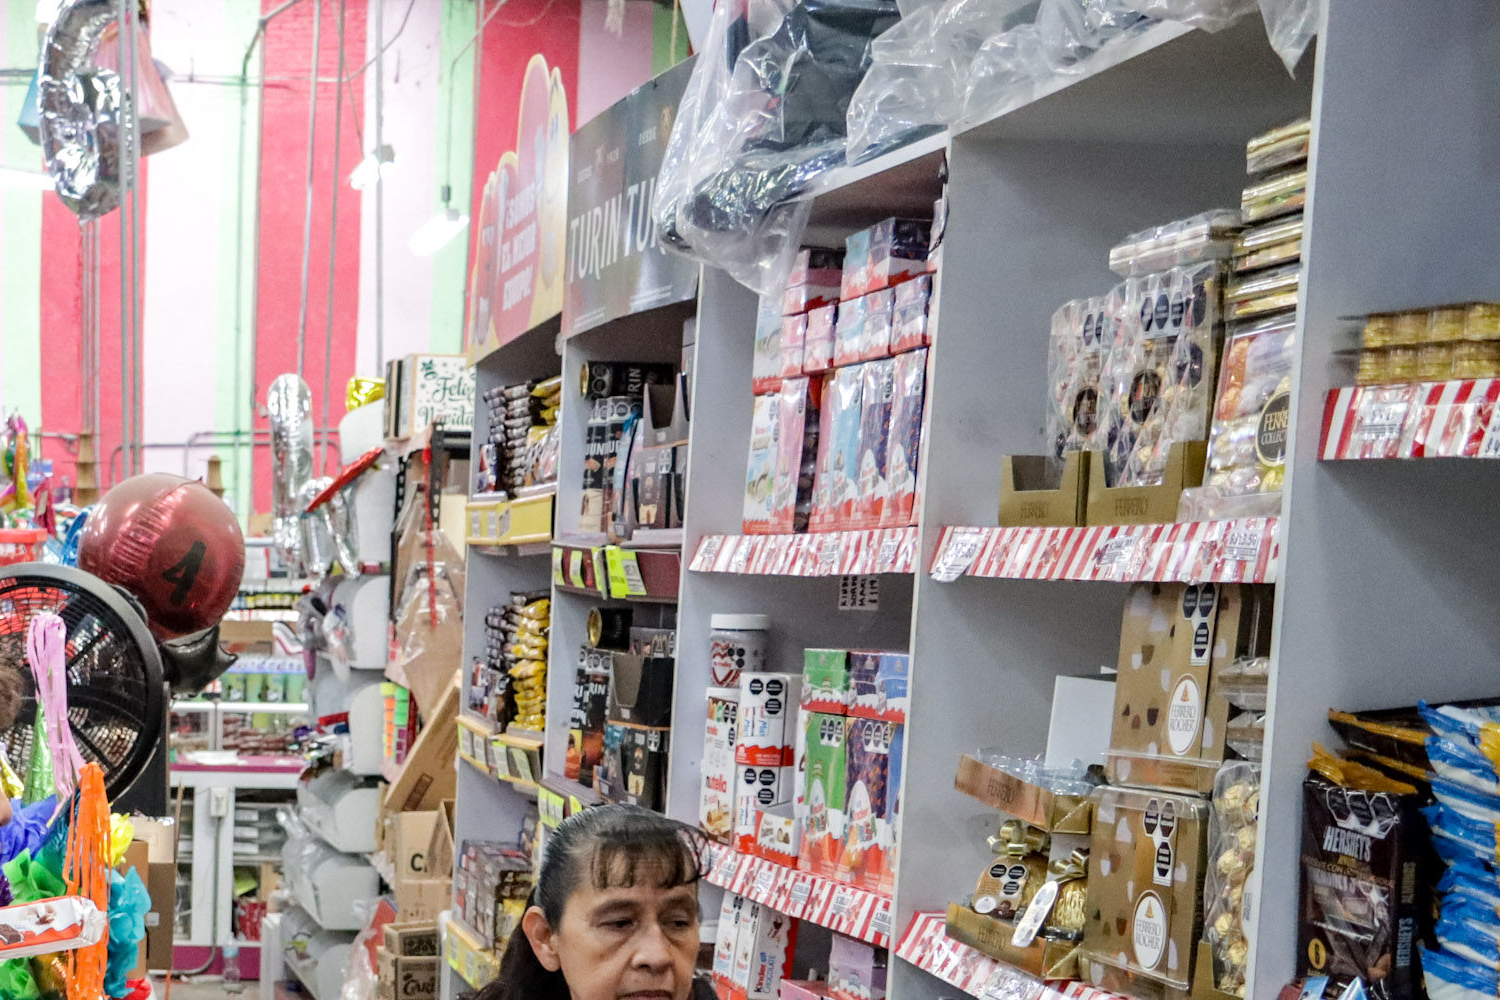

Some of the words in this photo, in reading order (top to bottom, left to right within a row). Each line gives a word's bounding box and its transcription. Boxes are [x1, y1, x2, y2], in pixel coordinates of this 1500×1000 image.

[569, 193, 623, 283] TURIN
[162, 540, 207, 605] 4
[1171, 704, 1196, 719] FERRERO
[1169, 718, 1195, 733] ROCHER
[1322, 826, 1372, 862] HERSHEY'S
[1135, 919, 1162, 938] FERRERO
[1135, 934, 1161, 952] ROCHER
[754, 963, 766, 993] Kinder
